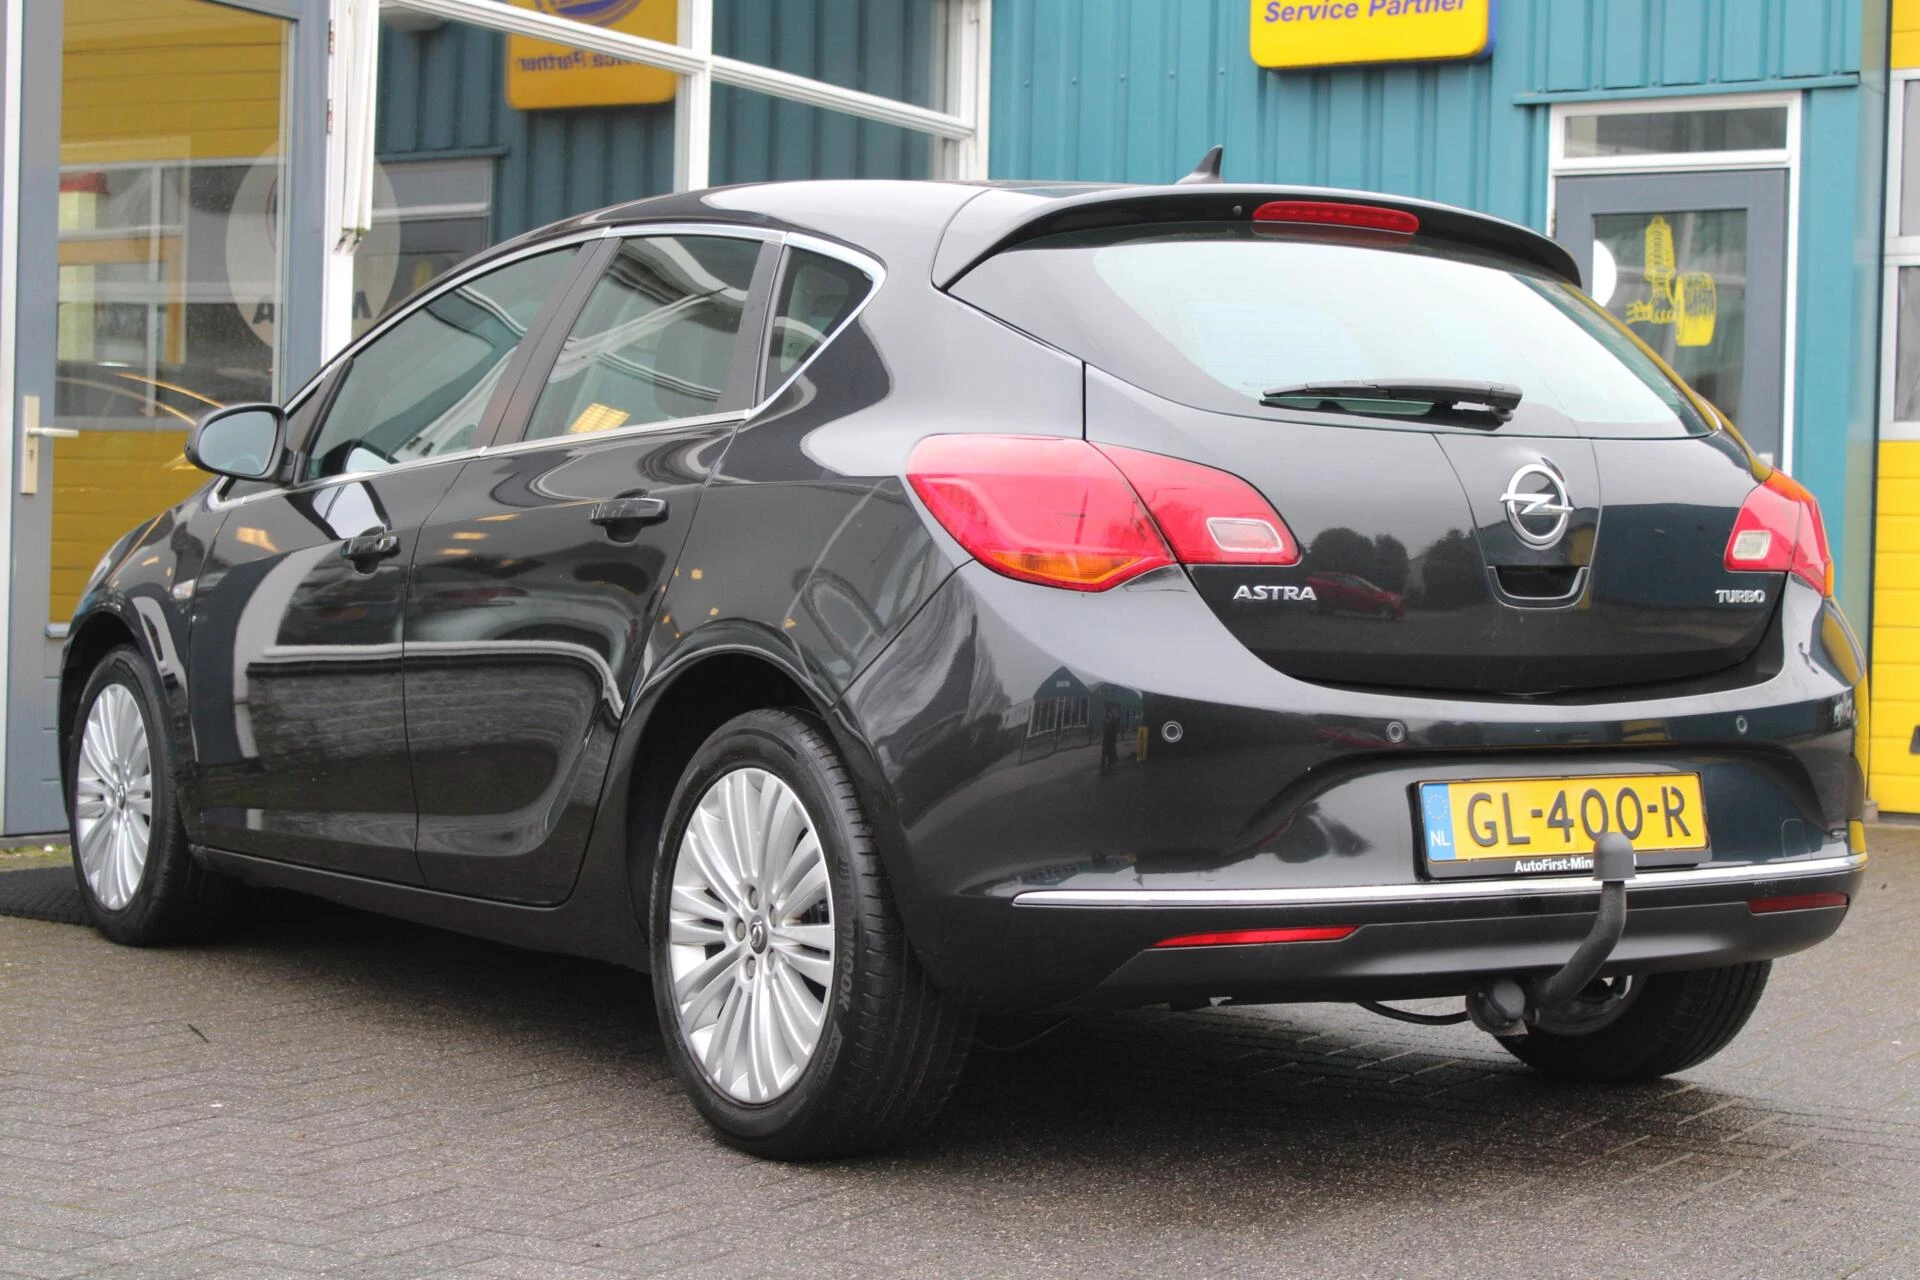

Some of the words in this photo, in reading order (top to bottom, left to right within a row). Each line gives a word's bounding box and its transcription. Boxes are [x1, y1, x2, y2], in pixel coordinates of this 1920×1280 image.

[1264, 0, 1359, 23] Service
[1368, 0, 1465, 17] Partner
[1232, 585, 1318, 600] ASTRA
[1715, 589, 1766, 603] TURBO
[1467, 786, 1691, 847] GL-400-R
[1430, 831, 1451, 847] NL
